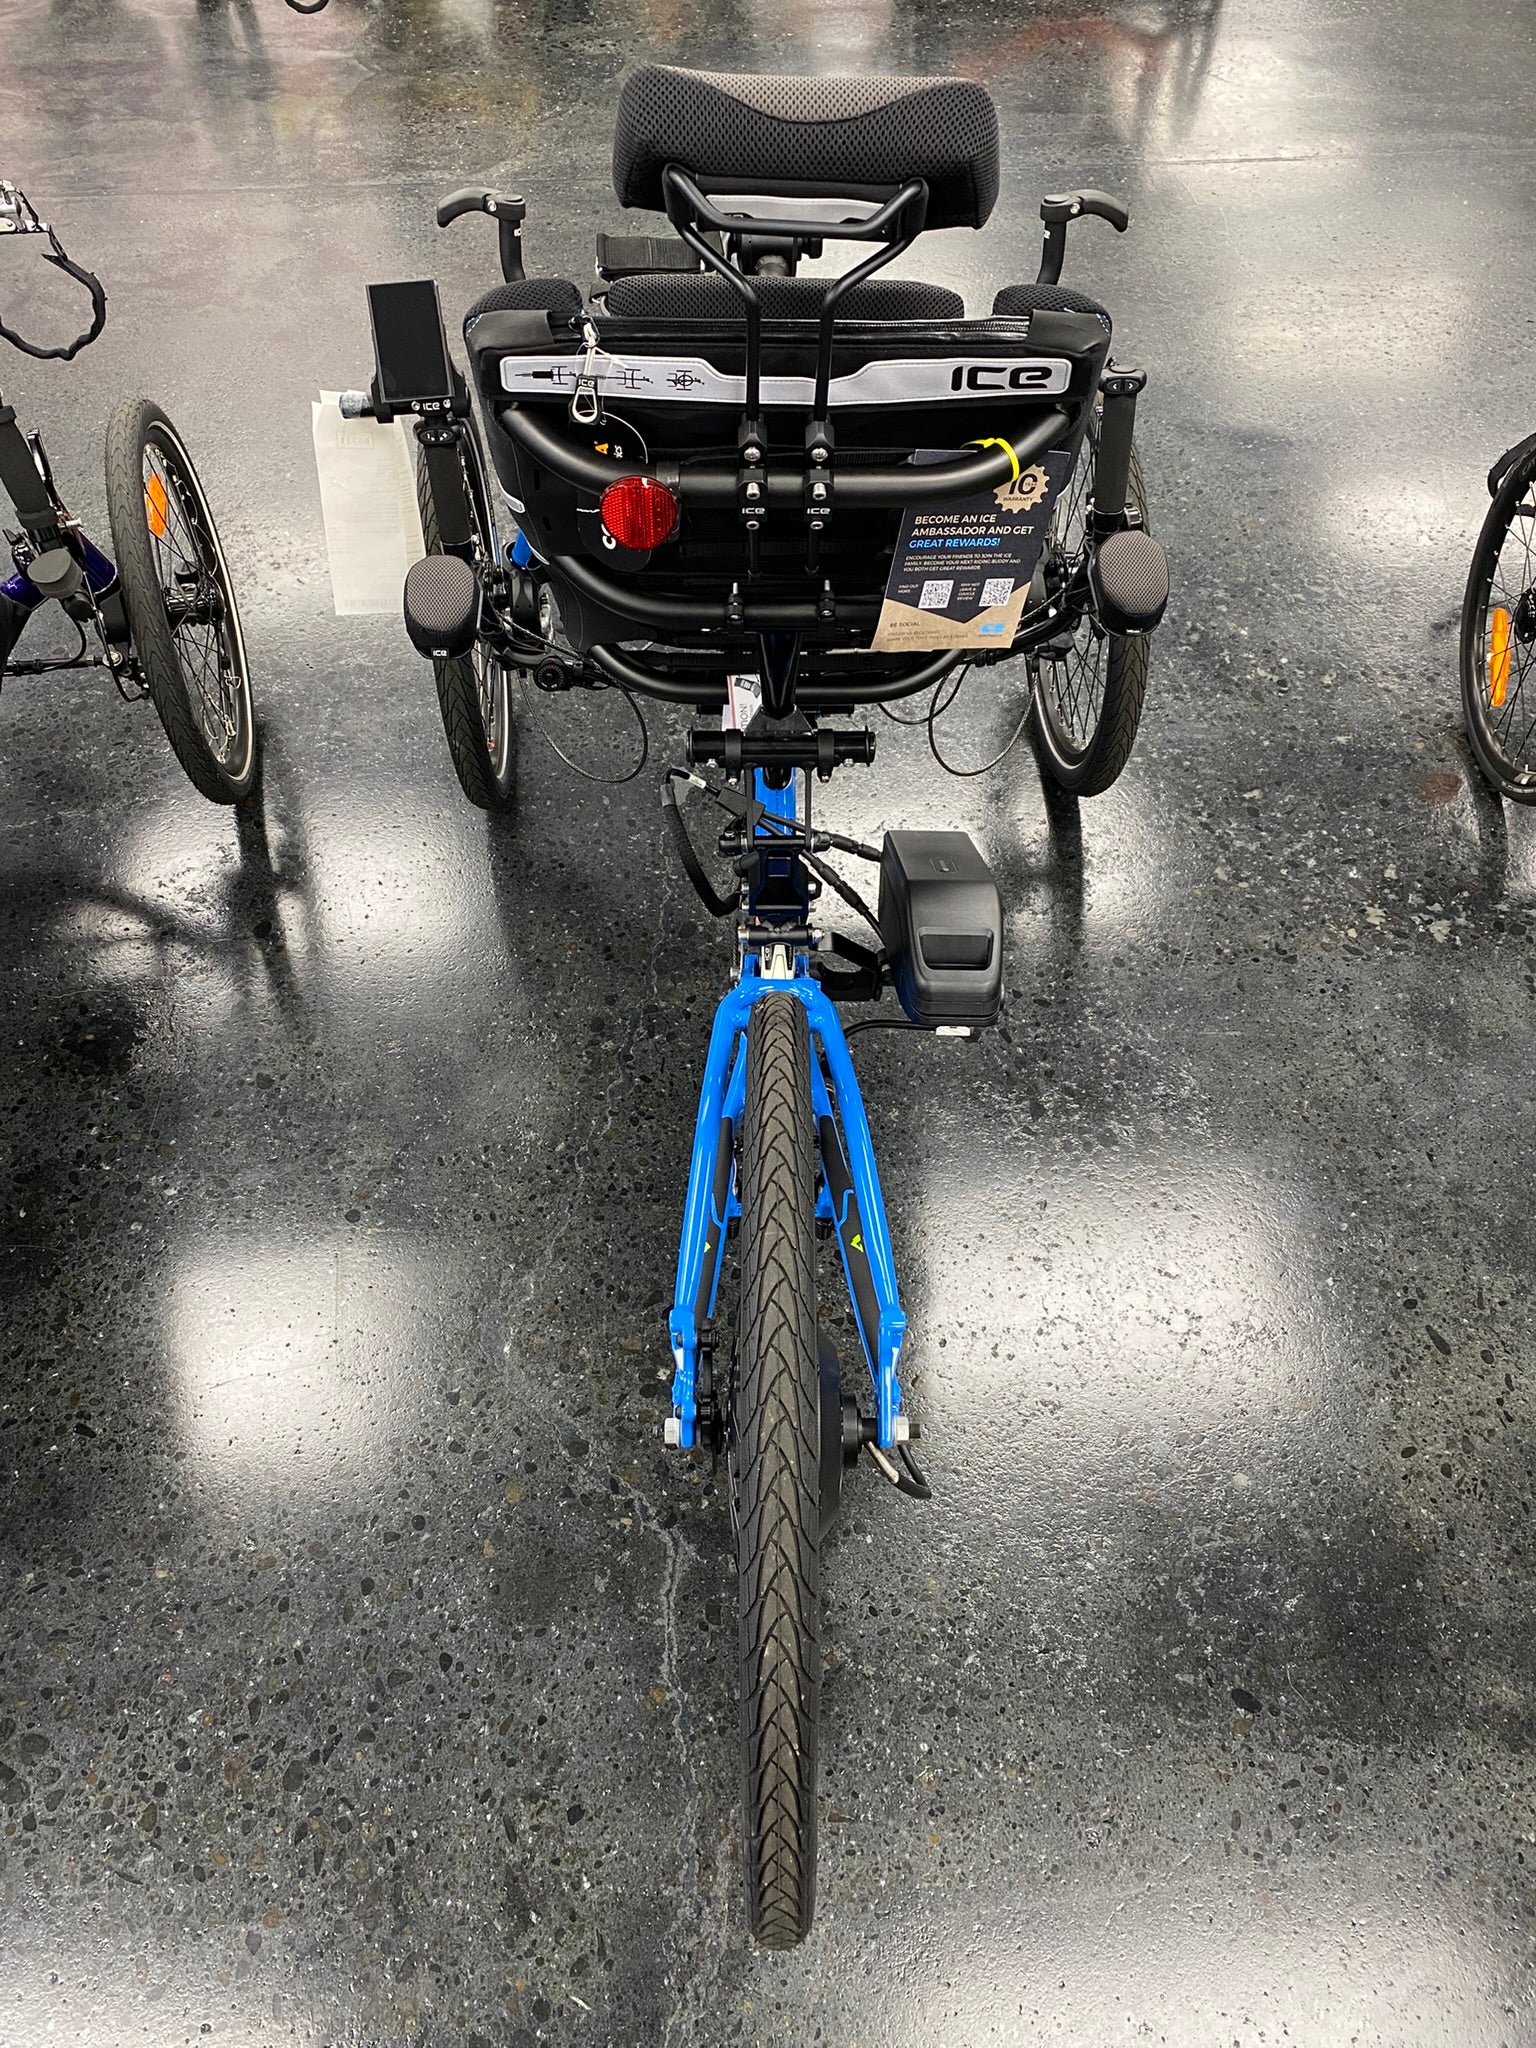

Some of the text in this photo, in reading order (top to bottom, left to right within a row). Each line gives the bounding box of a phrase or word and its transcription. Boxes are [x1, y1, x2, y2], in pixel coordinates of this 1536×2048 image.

[951, 366, 1053, 391] ICE
[914, 514, 997, 525] BECOME AN ICE
[911, 525, 1034, 537] AMBASSADOR AND GET
[908, 537, 1001, 549] GREAT REWARDS!
